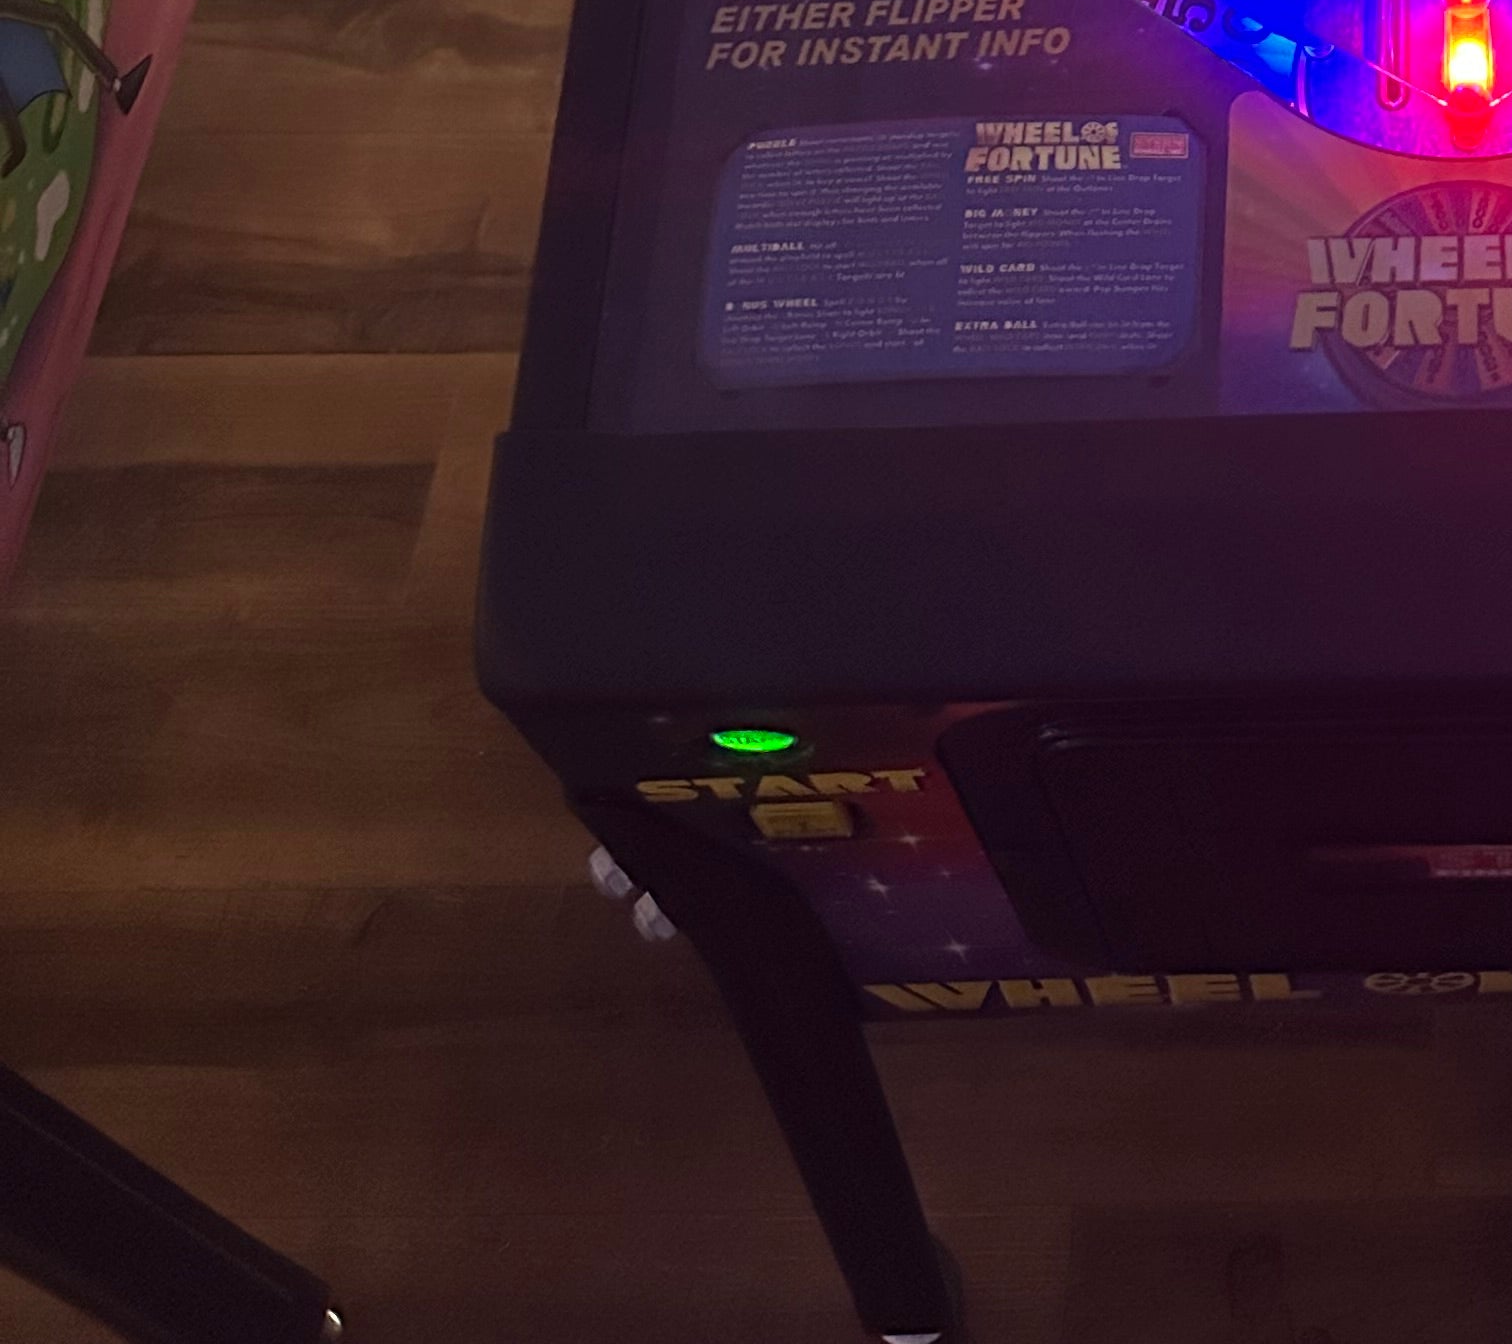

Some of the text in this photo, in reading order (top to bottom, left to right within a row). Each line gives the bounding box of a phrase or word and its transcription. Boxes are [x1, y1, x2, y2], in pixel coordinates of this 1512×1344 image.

[710, 1, 853, 34] EITHER
[705, 26, 1072, 71] FOR INSTANT INFO
[975, 120, 1081, 145] WHEEL
[963, 145, 1123, 173] FORTUNE
[966, 174, 1001, 185] FREE
[1004, 173, 1038, 184] SPIN
[960, 263, 1037, 274] WILD CARD
[954, 319, 1039, 332] EXTRA BALL
[634, 766, 928, 804] START
[861, 972, 1324, 1012] WHEEL
